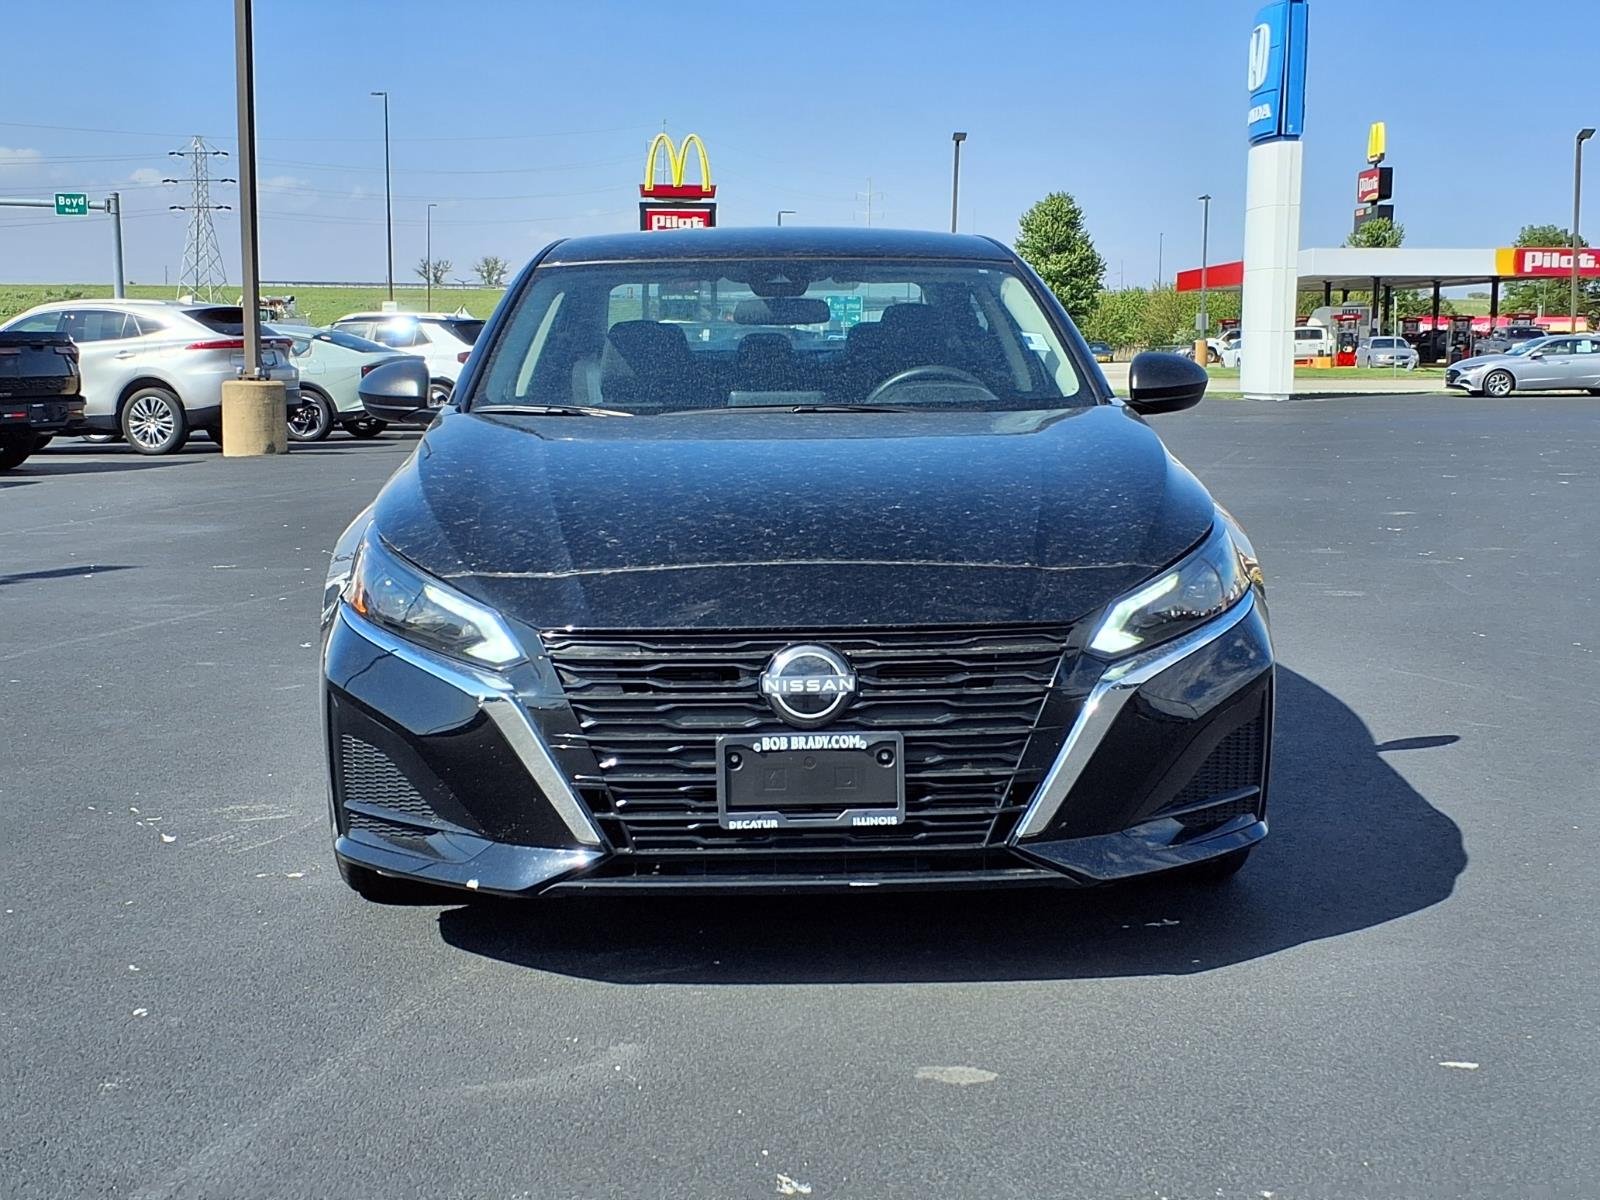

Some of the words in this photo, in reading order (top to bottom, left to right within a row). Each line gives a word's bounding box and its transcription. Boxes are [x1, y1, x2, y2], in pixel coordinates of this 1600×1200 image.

[58, 196, 84, 207] Boyd
[651, 214, 705, 231] Pilot
[1524, 251, 1596, 273] Pilot
[764, 677, 854, 693] NISSAN
[761, 736, 788, 751] BOB
[790, 734, 861, 751] BRADY.COM
[728, 818, 779, 830] DECATUR
[852, 816, 898, 827] ILLINOIS
